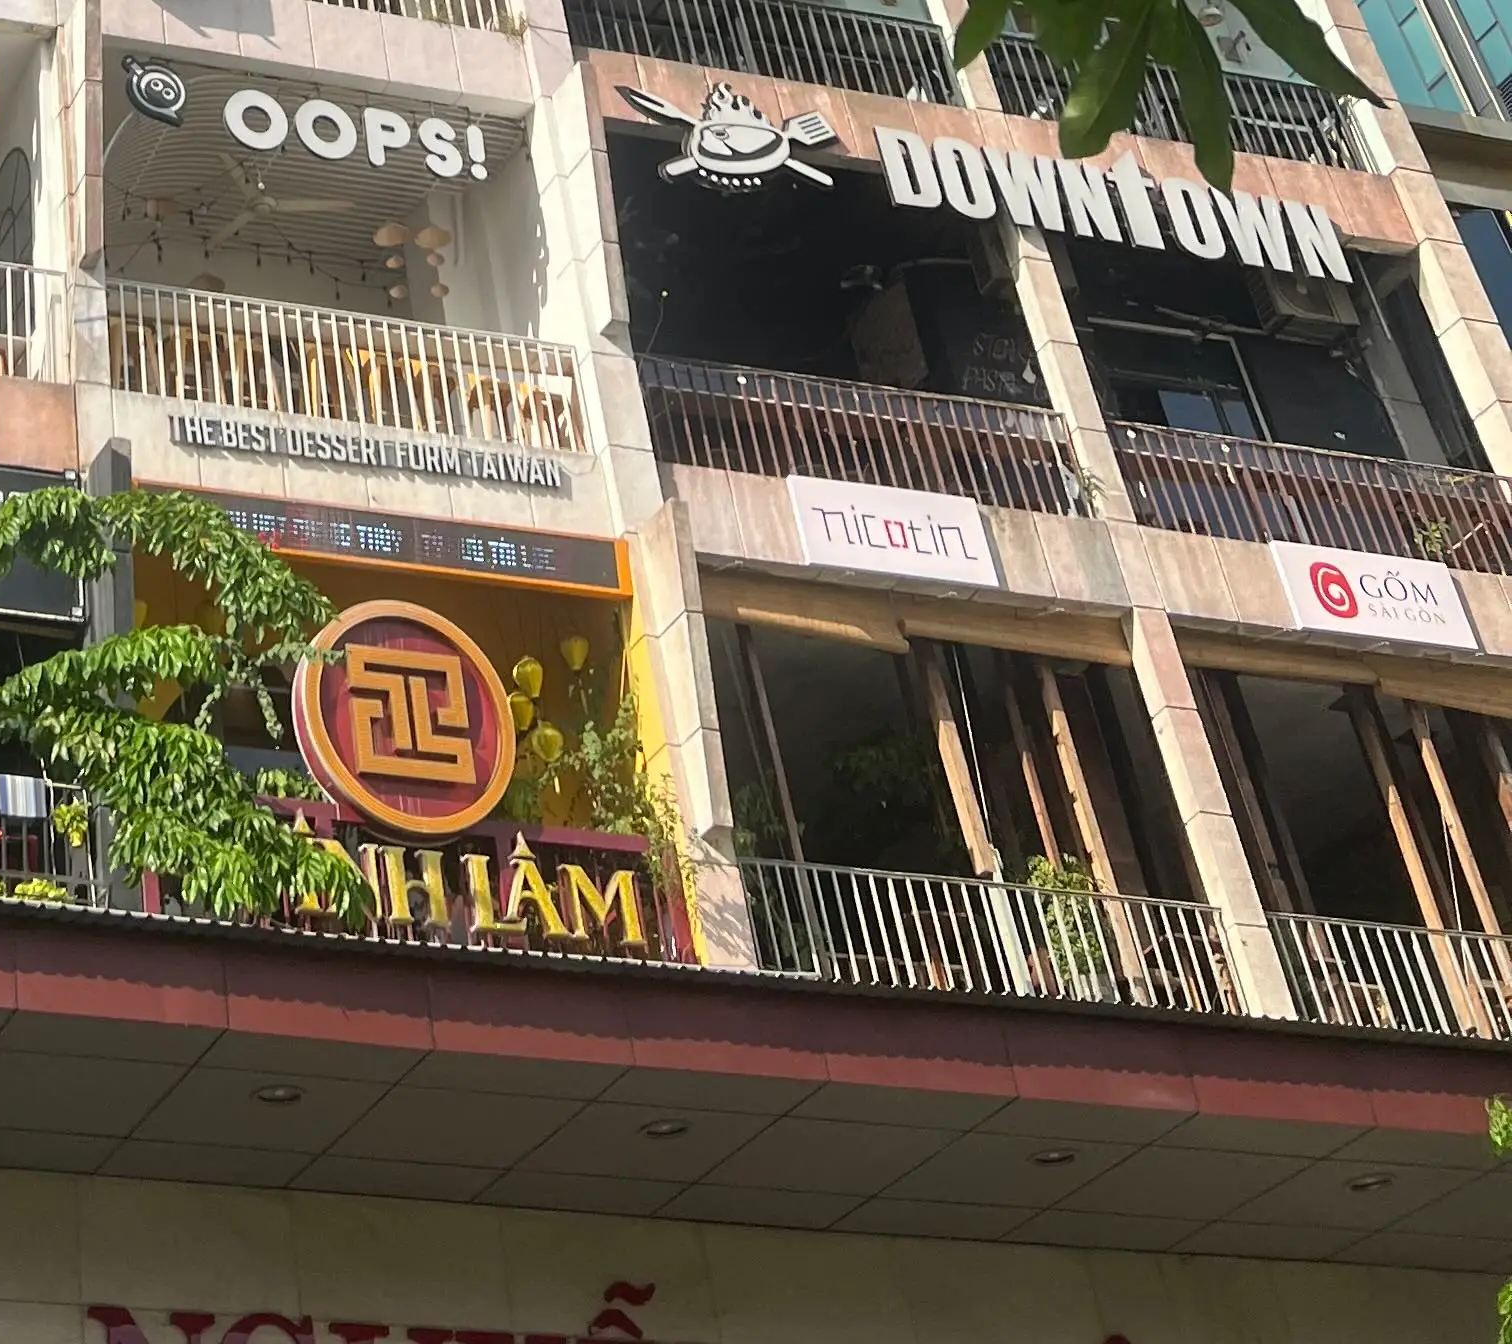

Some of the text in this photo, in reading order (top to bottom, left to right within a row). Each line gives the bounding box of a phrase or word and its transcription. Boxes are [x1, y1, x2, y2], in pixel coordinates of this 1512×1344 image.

[223, 89, 489, 182] OOPS!
[168, 415, 562, 489] THE BEST DESSERT FORM TAIWAN
[460, 830, 648, 948] LÂM
